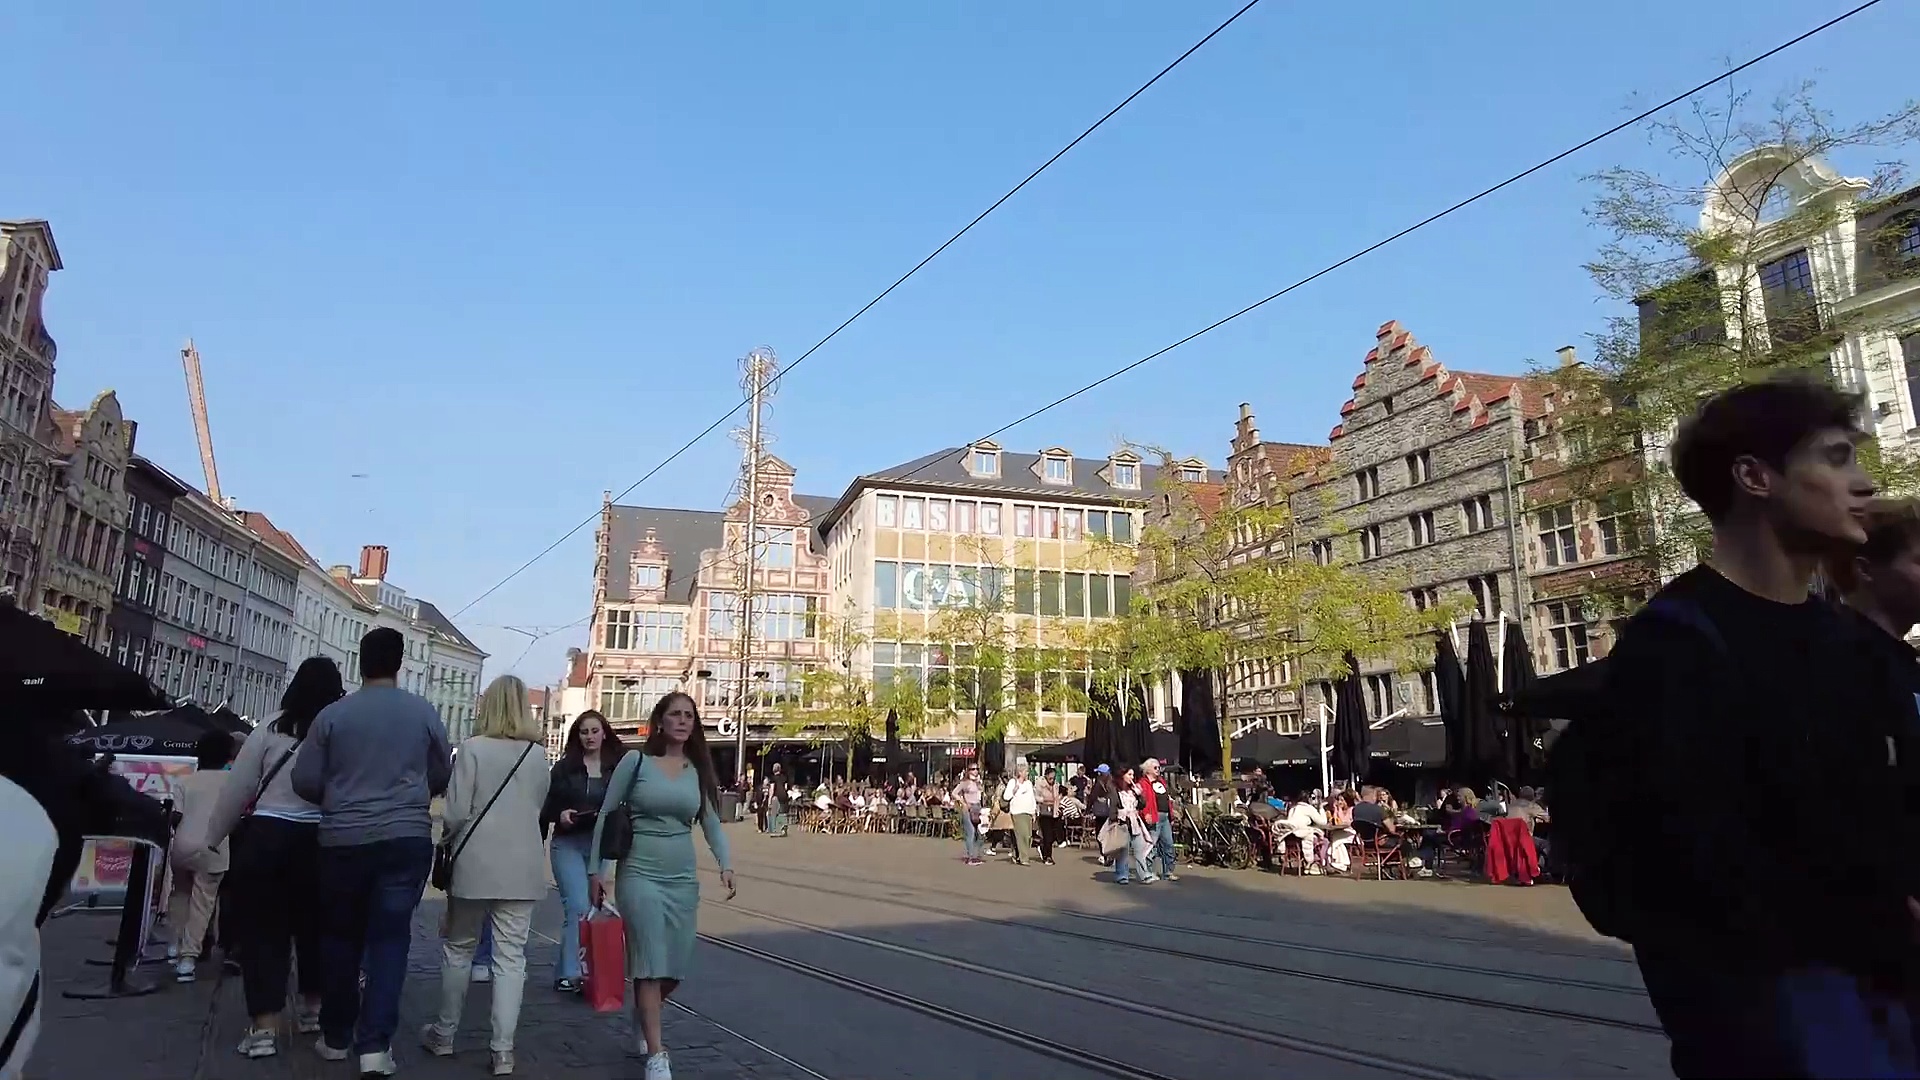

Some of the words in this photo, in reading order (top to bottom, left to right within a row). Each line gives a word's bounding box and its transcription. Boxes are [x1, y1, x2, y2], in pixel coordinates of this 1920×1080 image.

[877, 496, 999, 535] BASIC
[1017, 508, 1080, 539] FIT
[903, 567, 969, 605] C&A
